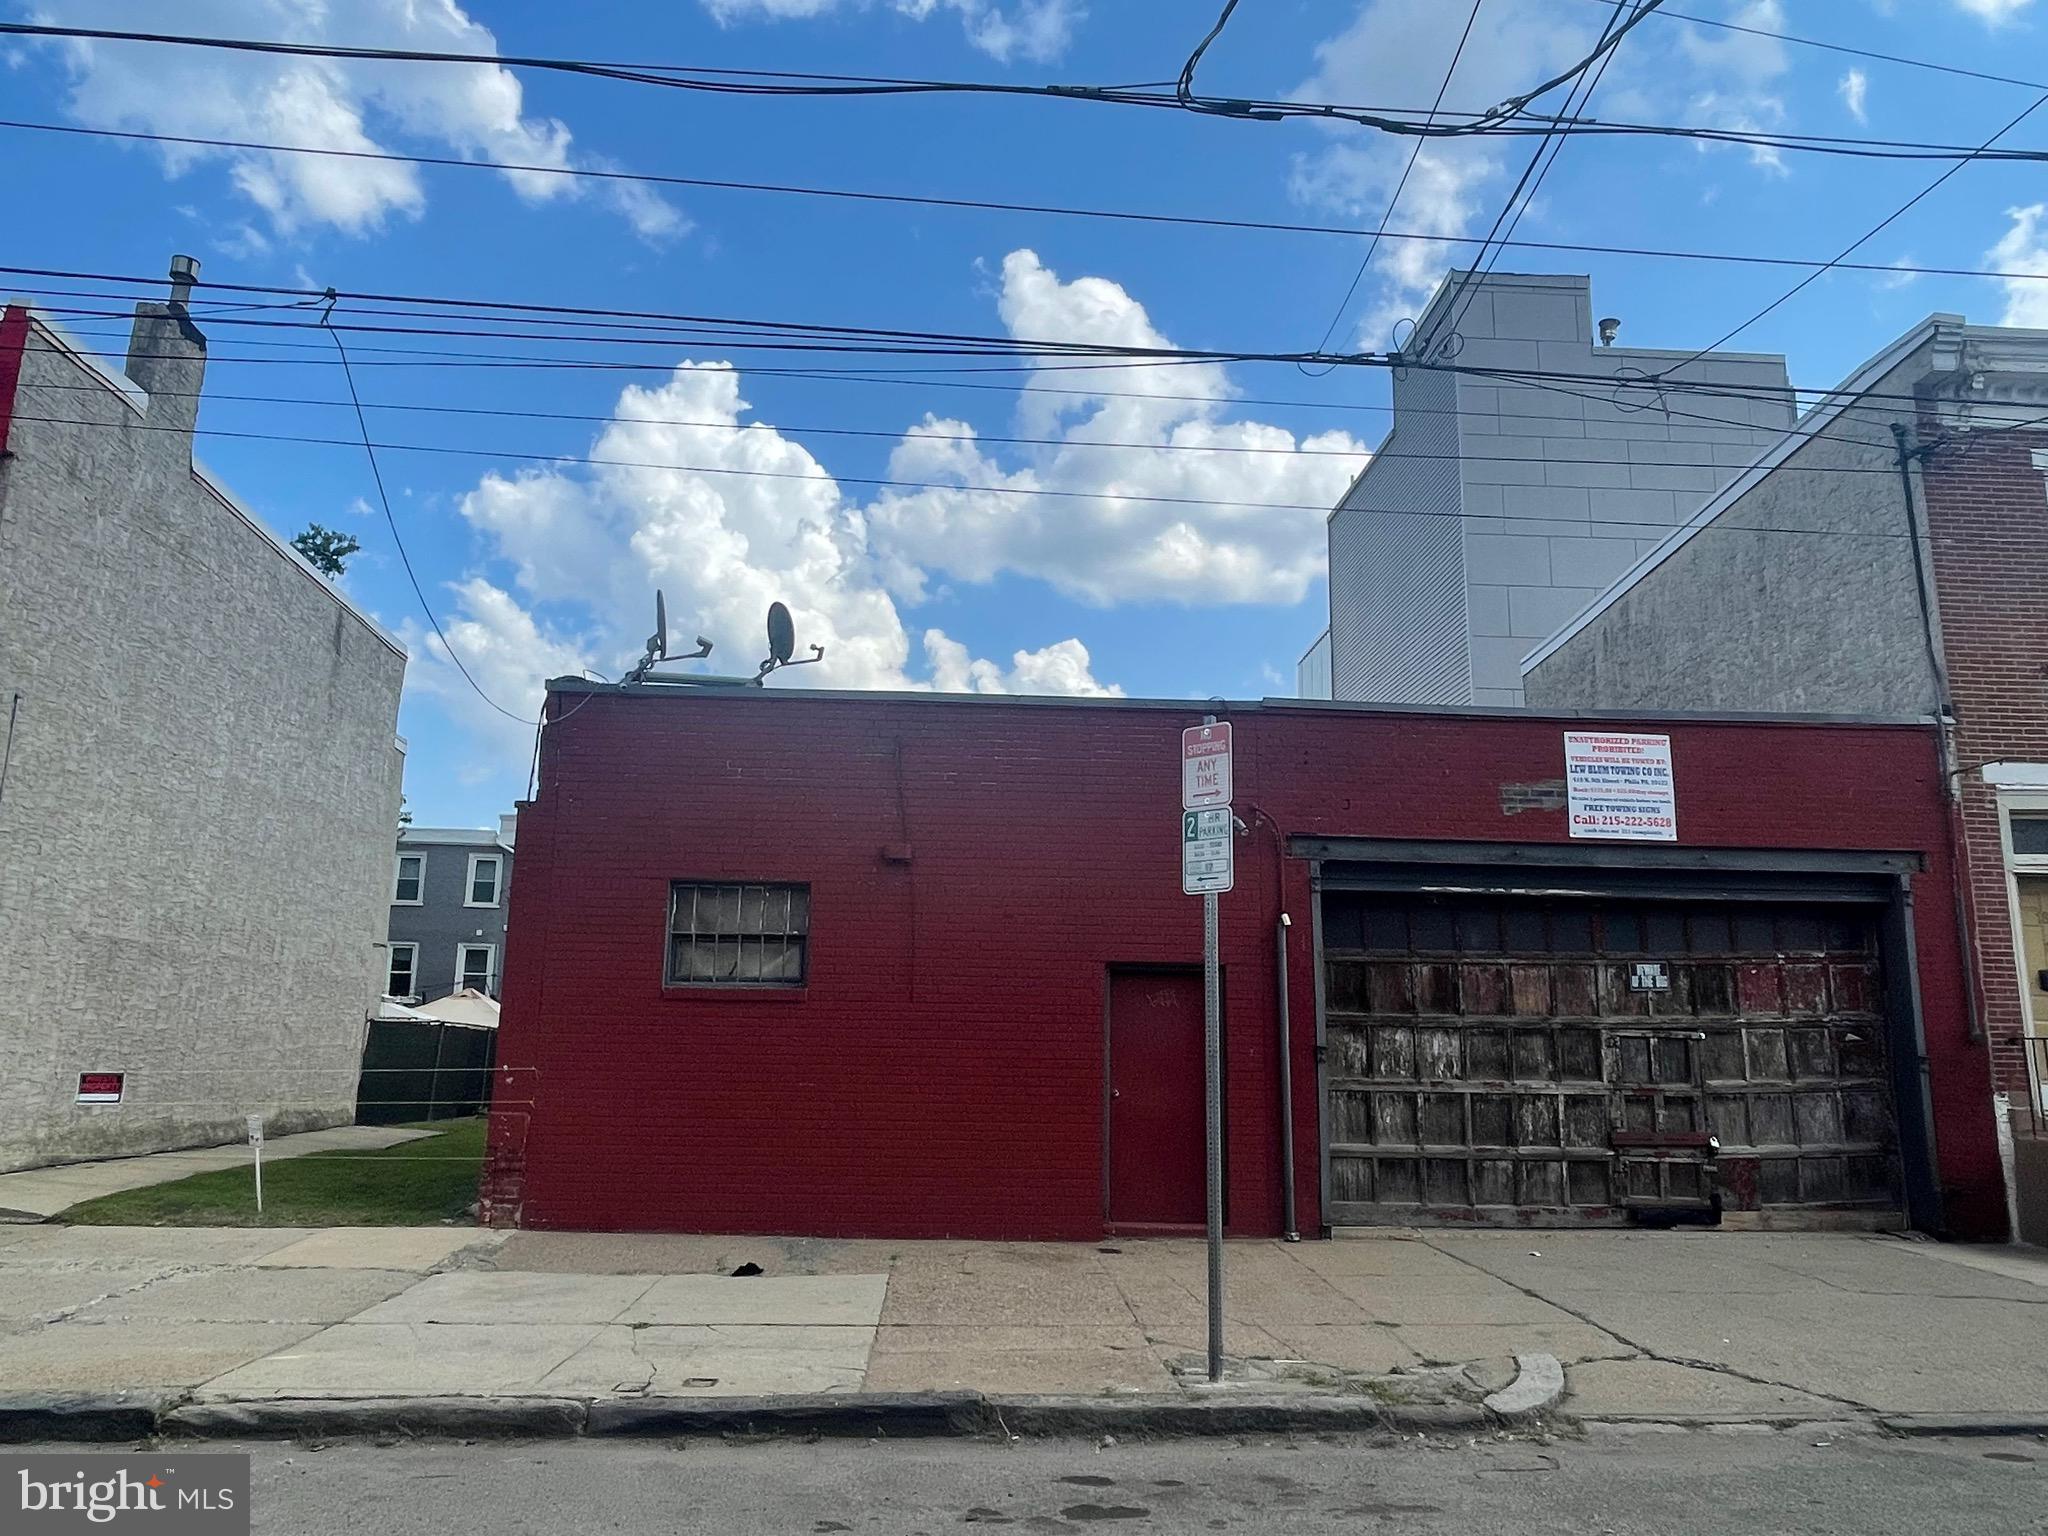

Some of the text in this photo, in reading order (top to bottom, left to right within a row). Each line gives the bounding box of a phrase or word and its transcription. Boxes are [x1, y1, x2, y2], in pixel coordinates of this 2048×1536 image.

[1187, 740, 1226, 756] STOPPING
[1197, 758, 1217, 773] ANY
[1570, 764, 1586, 774] LEW
[1610, 766, 1640, 777] TOWING
[1641, 767, 1652, 777] CO
[1196, 773, 1219, 788] TIME
[1187, 812, 1221, 838] 2 HR
[1573, 815, 1672, 828] Call: 215-222-5628
[1199, 824, 1228, 838] PARKING
